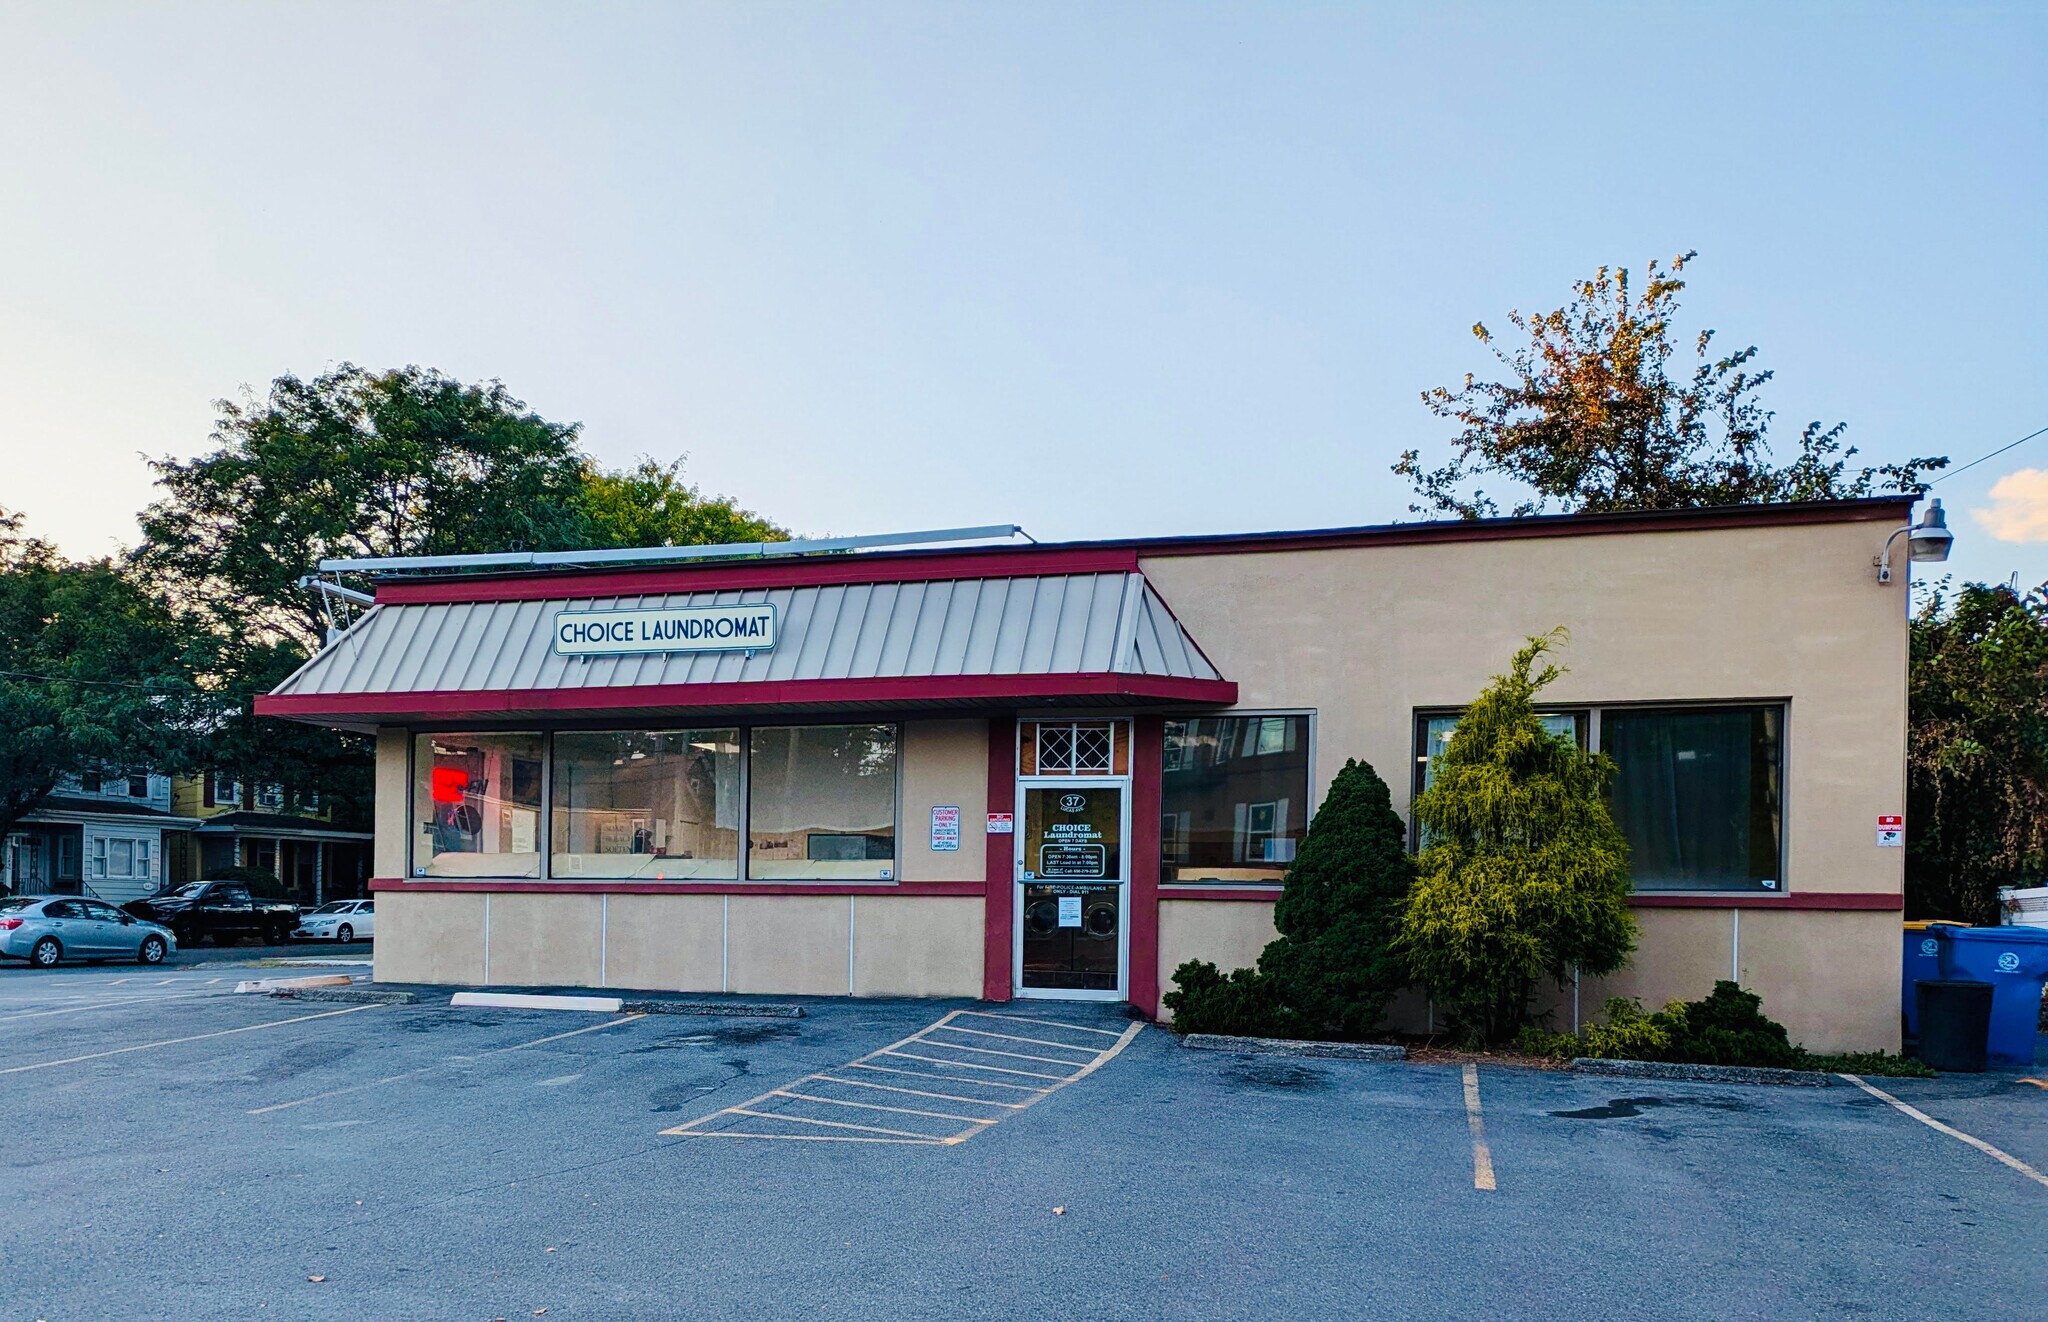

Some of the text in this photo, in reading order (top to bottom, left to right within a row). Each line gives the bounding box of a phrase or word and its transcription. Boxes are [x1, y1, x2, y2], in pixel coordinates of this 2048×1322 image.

[560, 616, 770, 643] CHOICE LAUNDROMAT
[1066, 797, 1079, 806] 37
